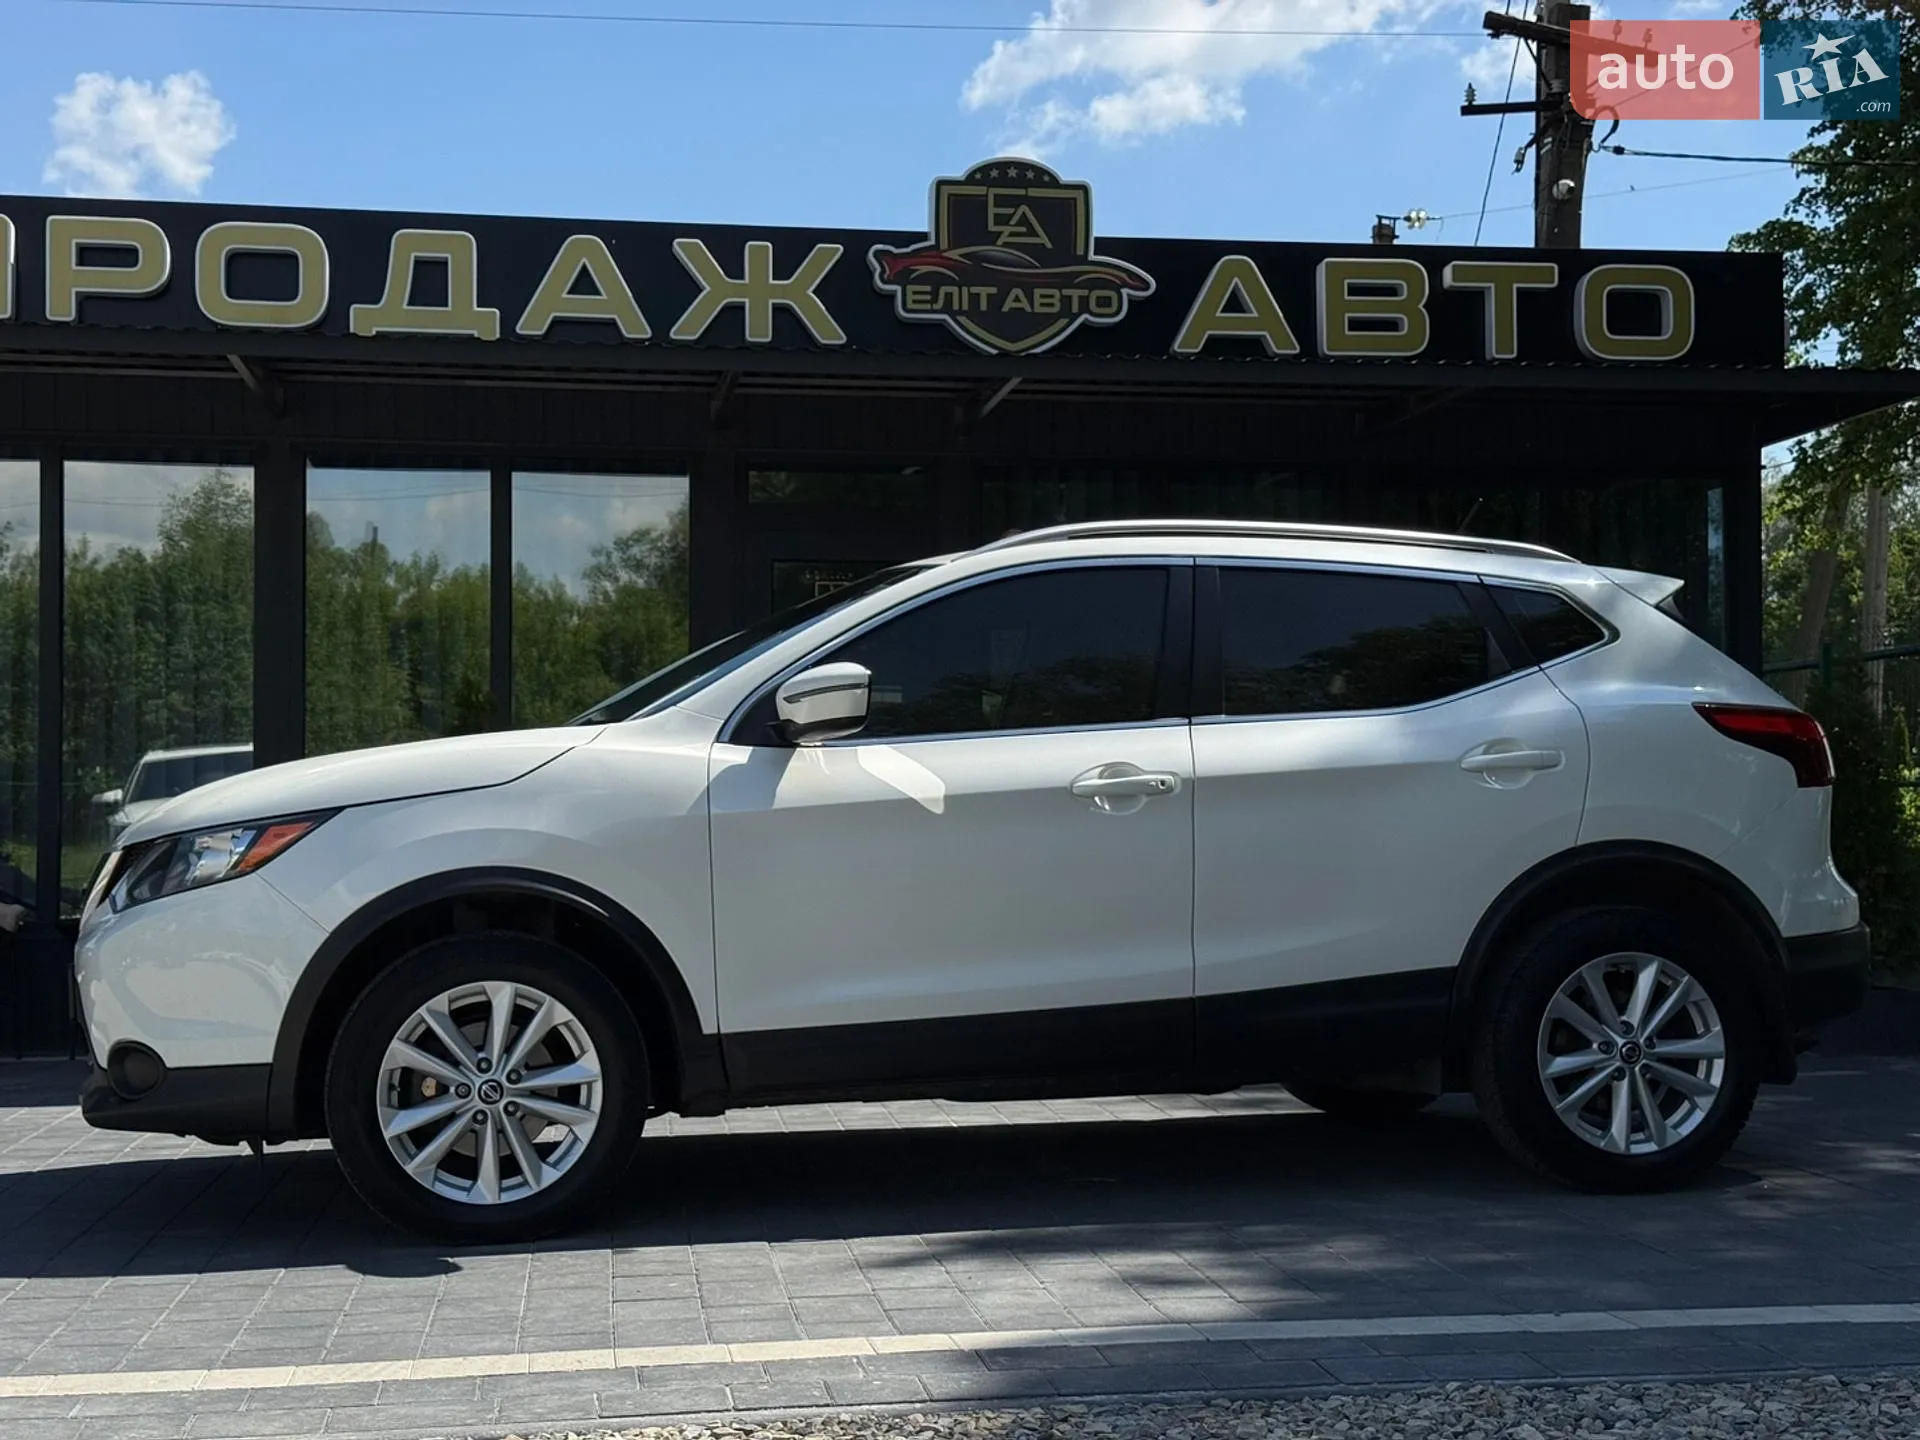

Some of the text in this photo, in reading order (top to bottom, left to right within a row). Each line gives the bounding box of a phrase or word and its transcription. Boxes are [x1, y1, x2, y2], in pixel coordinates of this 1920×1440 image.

[0, 213, 1695, 361] РОДАЖ АВТО
[906, 285, 1119, 315] ЕЛІТ АВТО
